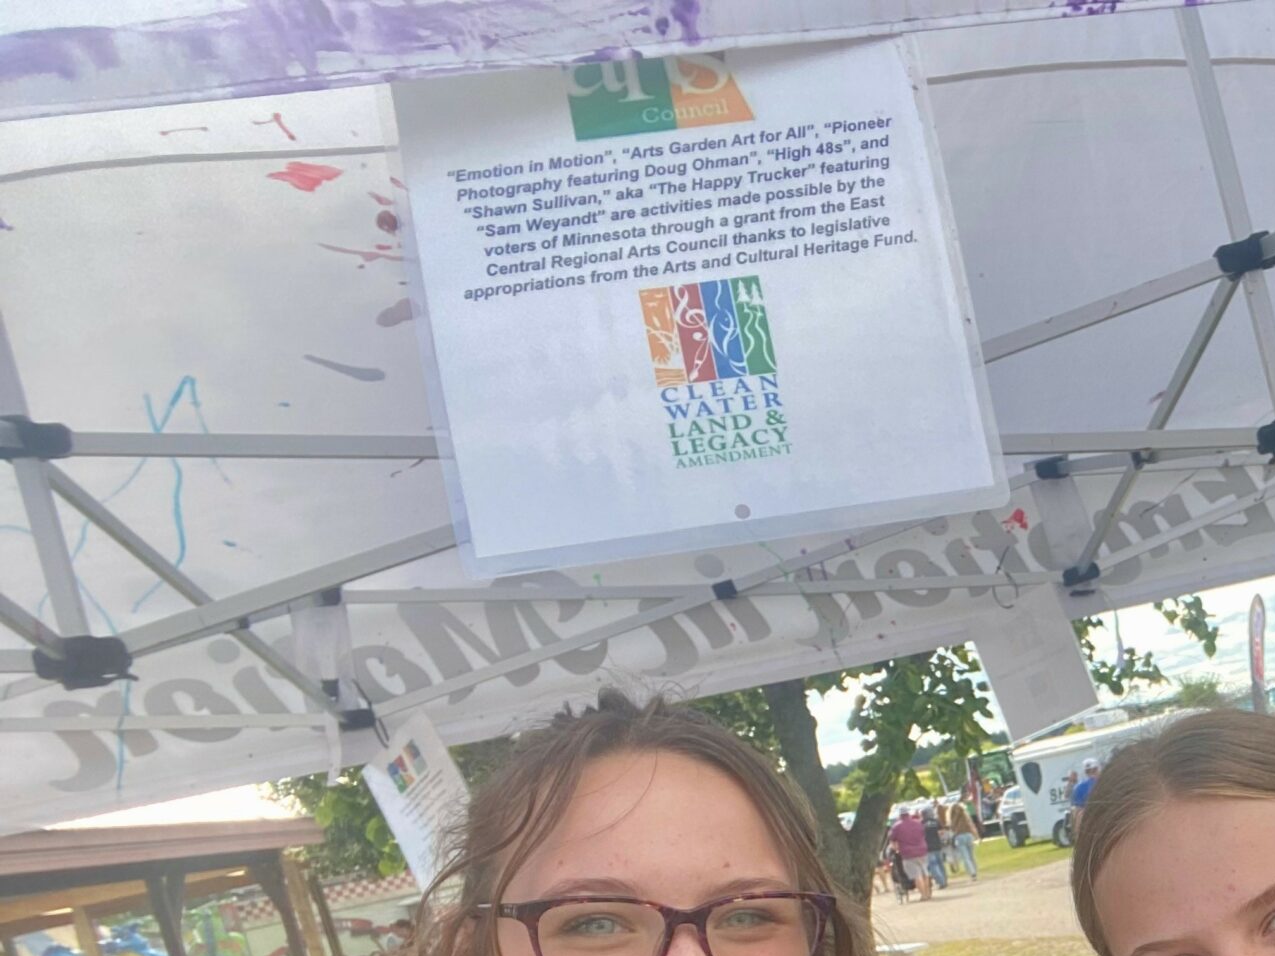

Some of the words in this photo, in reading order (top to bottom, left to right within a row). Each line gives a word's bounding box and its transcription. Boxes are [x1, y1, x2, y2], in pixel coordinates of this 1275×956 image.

[642, 99, 729, 124] Council
[447, 164, 525, 183] “Emotion
[529, 160, 545, 174] in
[549, 150, 617, 171] Motion”,
[622, 146, 665, 161] “Arts
[669, 138, 728, 155] Garden
[731, 133, 756, 148] Art
[759, 130, 783, 144] for
[785, 124, 820, 141] All”,
[824, 117, 893, 135] “Pioneer
[457, 178, 563, 203] Photography
[567, 168, 640, 188] featuring
[645, 163, 688, 178] Doug
[692, 151, 763, 172] Ohman”,
[767, 145, 812, 163] “High
[815, 139, 856, 156] 48s”,
[860, 134, 890, 151] and
[464, 203, 528, 220] “Shawn
[532, 189, 612, 212] Sullivan,”
[615, 187, 644, 202] aka
[649, 181, 688, 196] “The
[692, 175, 744, 192] Happy
[747, 163, 816, 184] Trucker”
[820, 156, 890, 176] featuring
[476, 224, 522, 238] “Sam
[526, 209, 607, 233] Weyandt”
[610, 209, 637, 222] are
[640, 198, 713, 218] activities
[717, 191, 762, 208] made
[765, 182, 833, 205] possible
[837, 179, 857, 195] by
[860, 176, 886, 190] the
[484, 241, 537, 258] voters
[541, 235, 559, 250] of
[562, 226, 647, 248] Minnesota
[651, 216, 715, 237] through
[719, 217, 730, 228] a
[733, 209, 776, 229] grant
[779, 206, 817, 220] from
[820, 201, 846, 215] the
[850, 195, 886, 211] East
[486, 257, 547, 277] Central
[551, 247, 624, 270] Regional
[627, 244, 662, 260] Arts
[666, 234, 728, 255] Council
[732, 228, 787, 246] thanks
[790, 226, 807, 239] to
[811, 216, 891, 238] legislative
[464, 275, 586, 302] appropriations
[590, 269, 629, 284] from
[632, 264, 659, 279] the
[662, 260, 697, 275] Arts
[701, 253, 732, 270] and
[736, 244, 799, 265] Cultural
[803, 239, 870, 257] Heritage
[874, 230, 918, 248] Fund.
[660, 374, 779, 403] CLEAN
[664, 392, 783, 420] WATER
[668, 414, 752, 439] LAND
[766, 409, 787, 426] &
[671, 426, 788, 457] LEGACY
[676, 444, 793, 469] AMENDMENT
